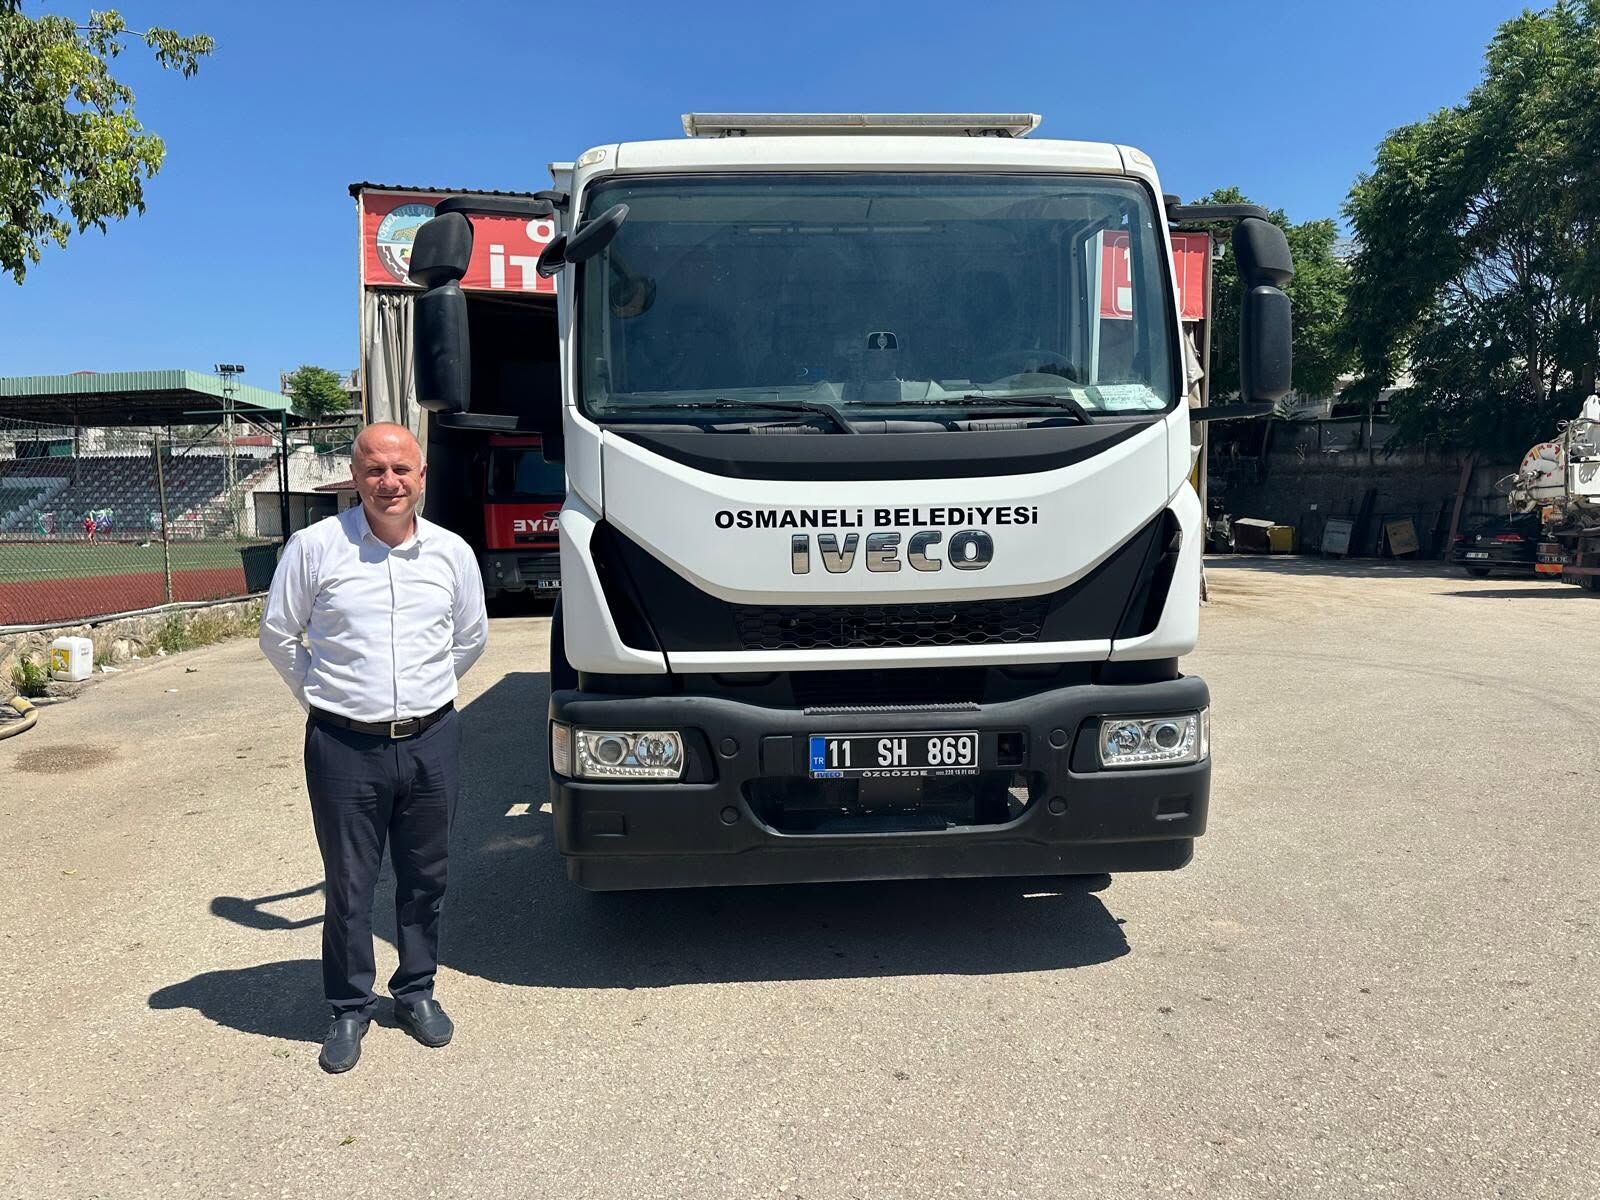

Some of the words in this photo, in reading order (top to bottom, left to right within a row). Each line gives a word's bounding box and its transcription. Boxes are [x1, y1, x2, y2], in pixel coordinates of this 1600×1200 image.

[791, 529, 994, 575] IVECO
[813, 757, 824, 765] TR
[829, 740, 851, 767] 11
[877, 738, 907, 766] SH
[927, 737, 972, 765] 869
[862, 769, 928, 777] ÖZGÖZDE
